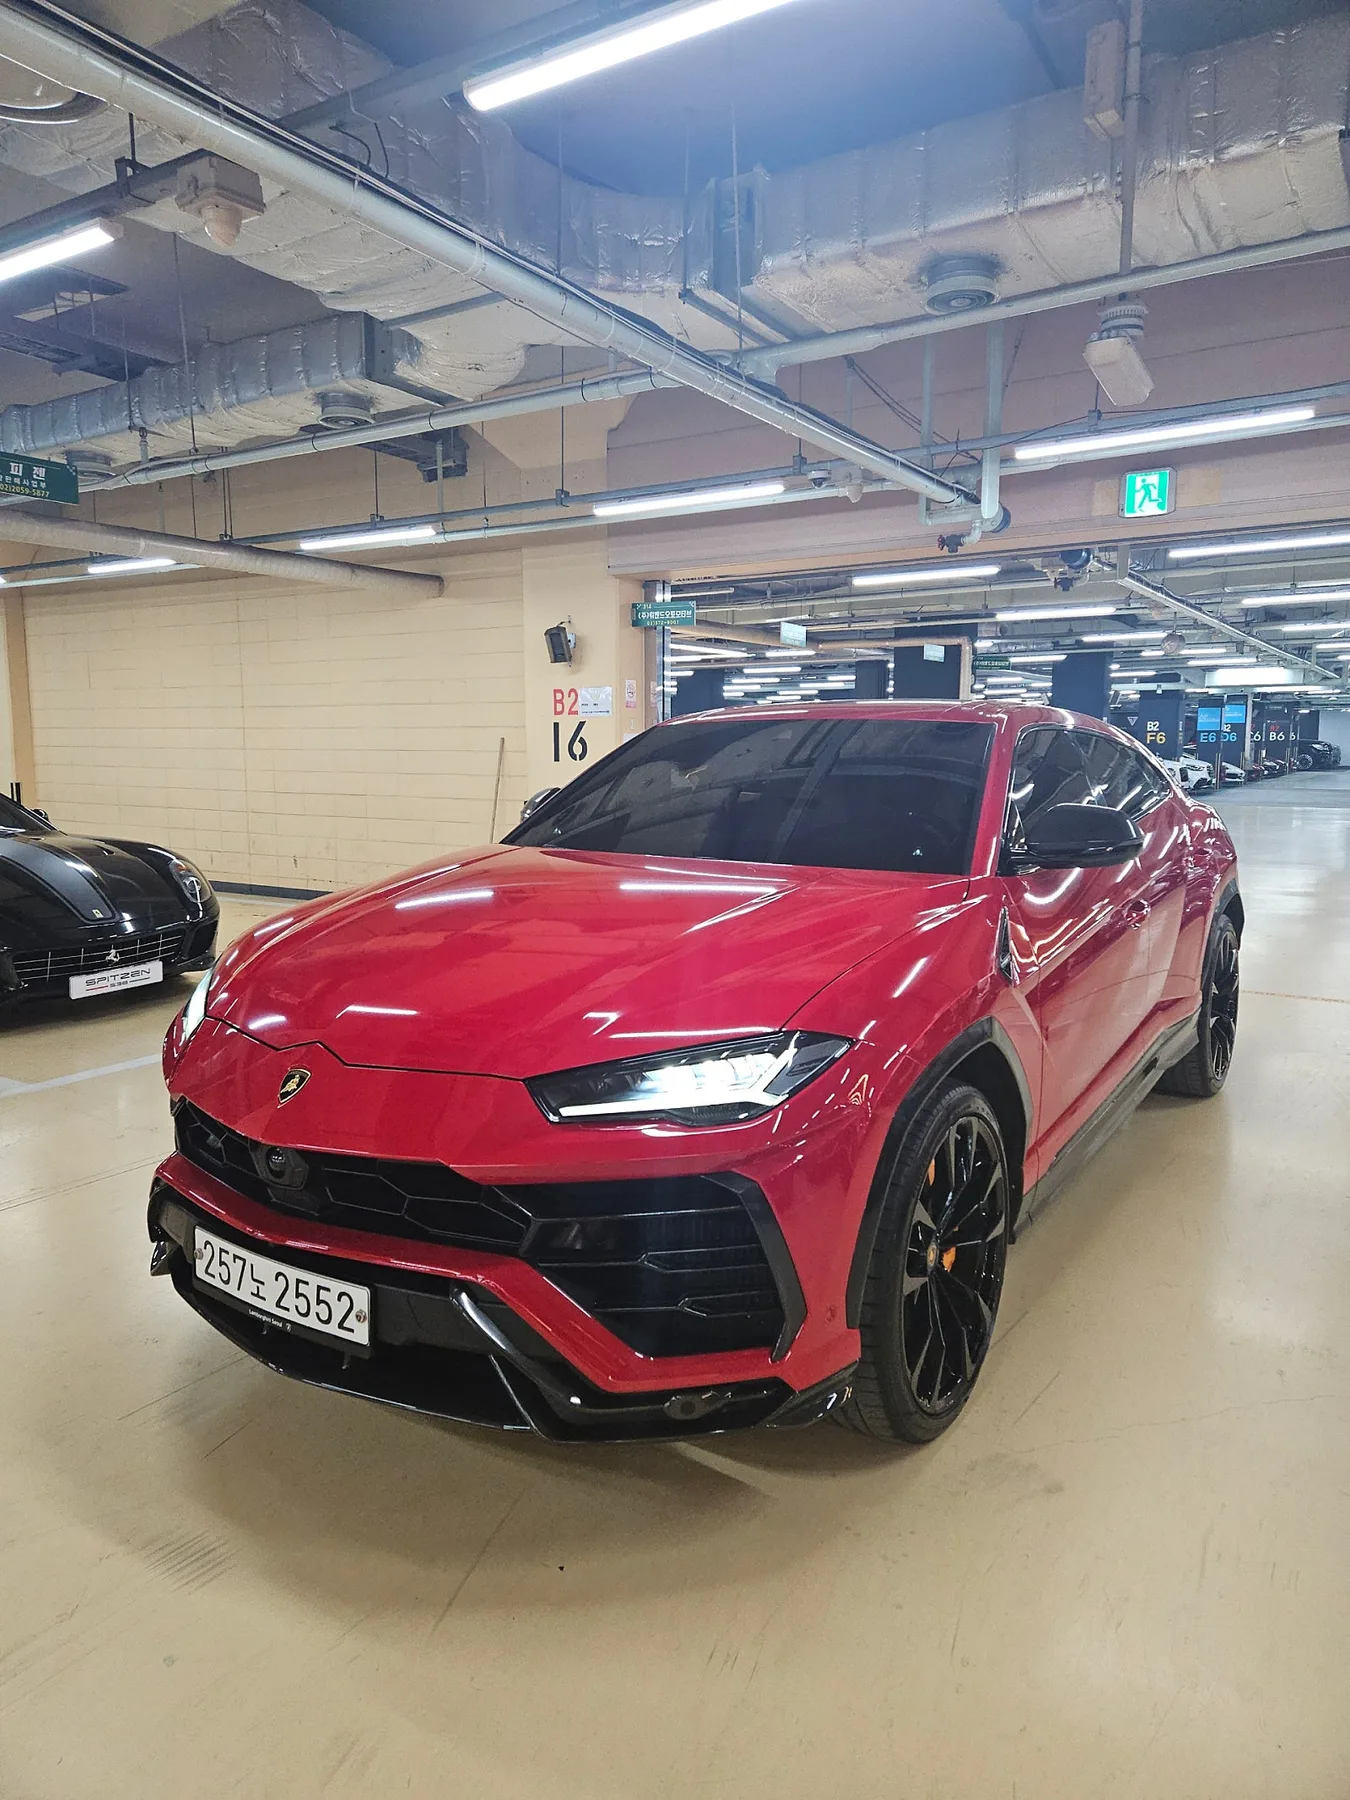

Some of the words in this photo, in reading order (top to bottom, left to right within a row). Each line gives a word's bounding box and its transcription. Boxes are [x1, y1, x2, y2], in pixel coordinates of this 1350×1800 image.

[553, 688, 579, 716] B2
[1146, 721, 1160, 731] B2
[553, 721, 588, 762] 16
[1146, 732, 1166, 744] F6
[1200, 732, 1217, 743] E6
[1250, 731, 1261, 741] 6
[1269, 732, 1285, 741] B6
[85, 968, 151, 987] SPITZEN
[203, 1240, 266, 1301] 257노
[274, 1271, 355, 1334] 2552
